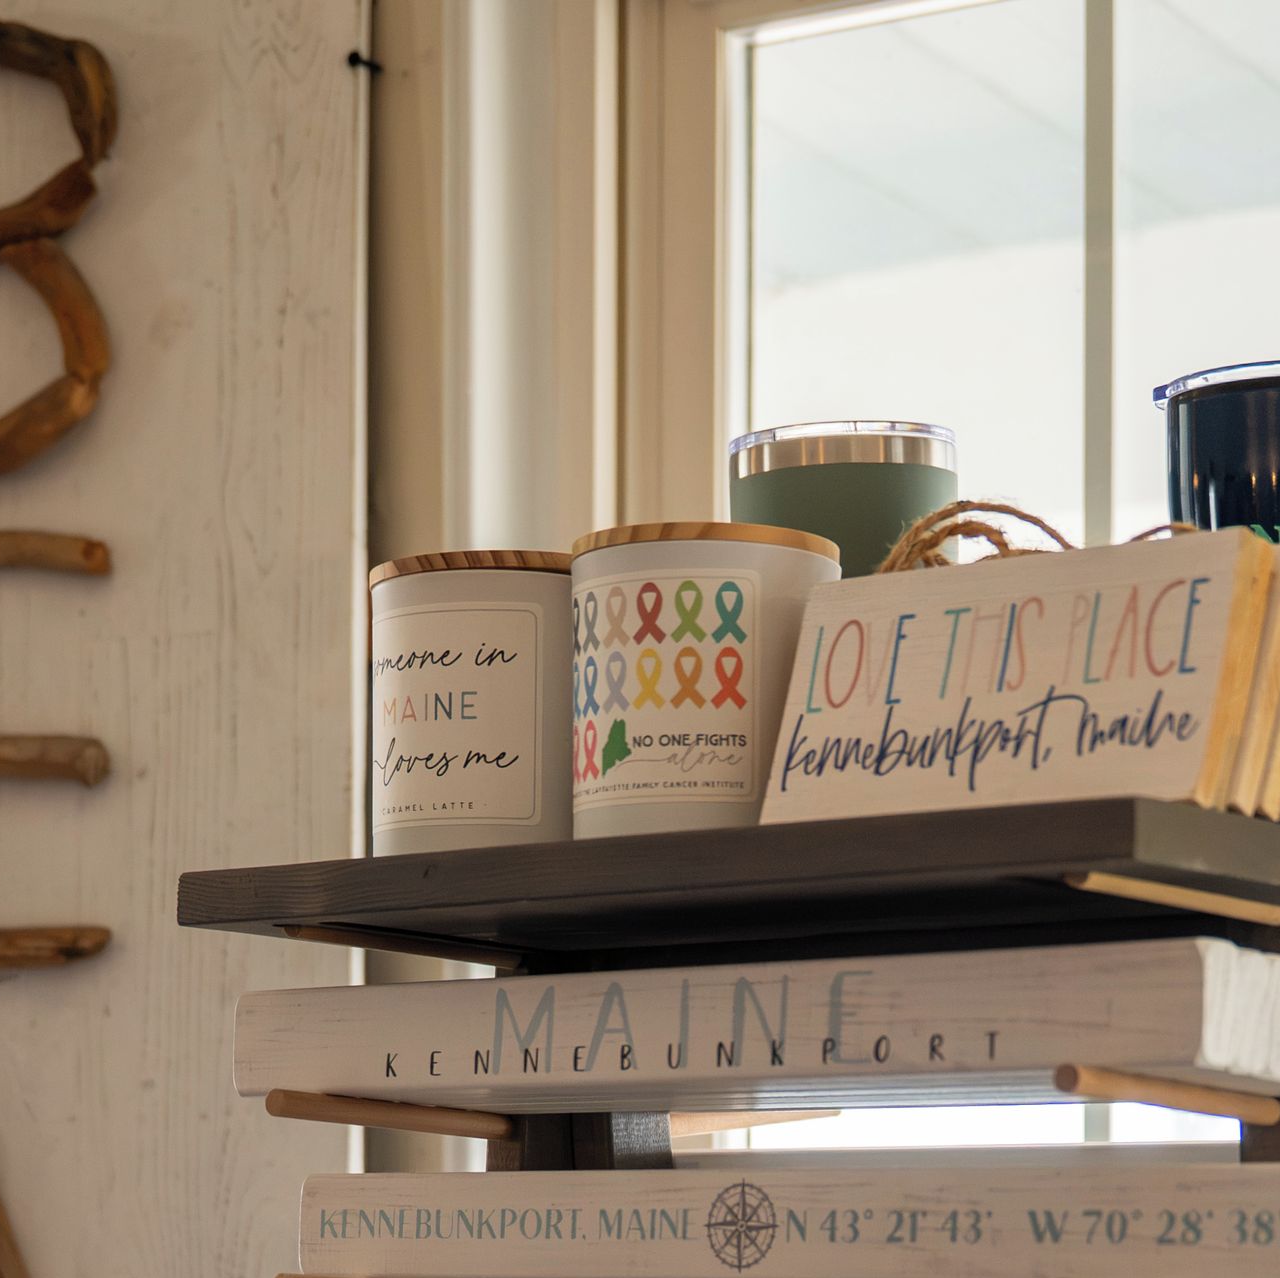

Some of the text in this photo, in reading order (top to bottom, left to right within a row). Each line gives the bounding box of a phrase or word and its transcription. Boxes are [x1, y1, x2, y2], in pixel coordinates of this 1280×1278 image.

[373, 643, 518, 680] omeone in
[806, 577, 1211, 714] LOVE THIS PLACE
[382, 691, 478, 728] MAINE
[632, 733, 748, 749] NO ONE FIGHTS
[636, 742, 744, 773] alone
[373, 737, 520, 787] loves me
[632, 781, 660, 790] FAMILY
[662, 780, 698, 789] CANCER
[702, 780, 745, 790] INSTITUTE
[381, 801, 475, 816] CARAMEL LATTE
[492, 969, 873, 1076] MAINE
[385, 1029, 1000, 1079] KENNEBUNKPORT
[598, 1208, 699, 1241] MAINE
[786, 1209, 808, 1243] N
[1027, 1209, 1069, 1244] W
